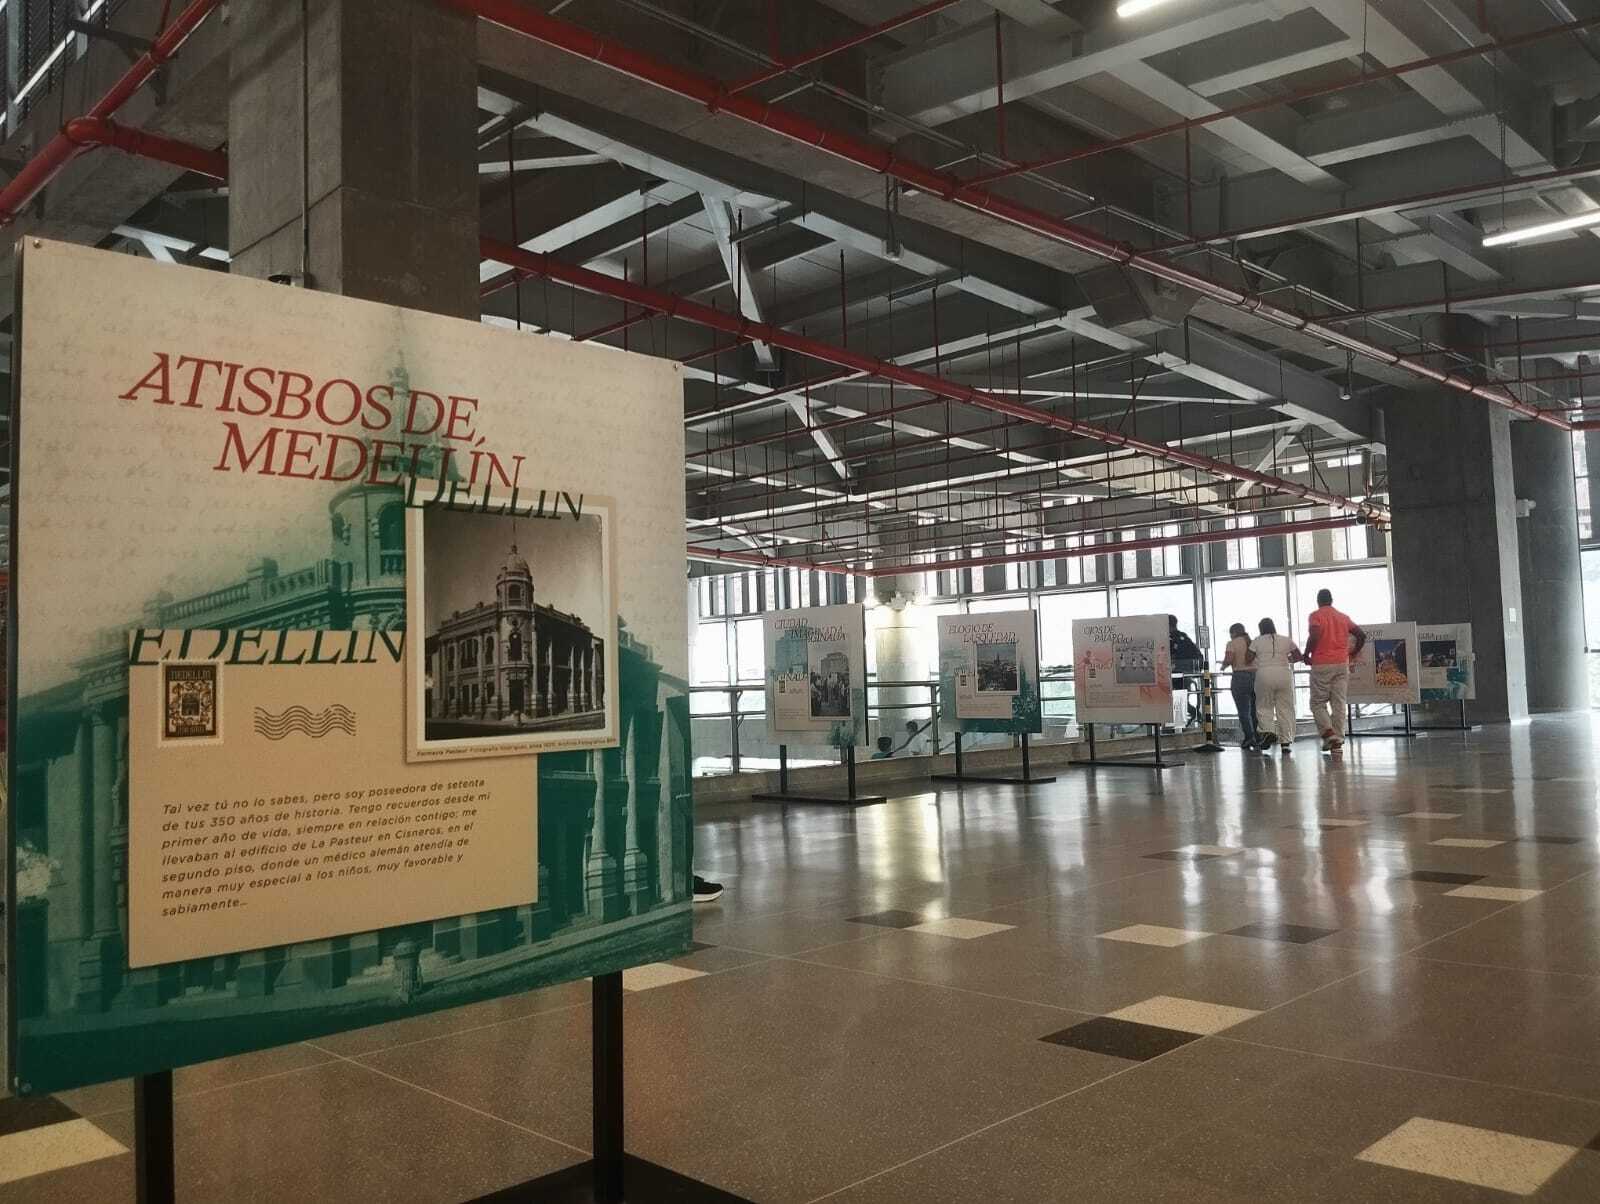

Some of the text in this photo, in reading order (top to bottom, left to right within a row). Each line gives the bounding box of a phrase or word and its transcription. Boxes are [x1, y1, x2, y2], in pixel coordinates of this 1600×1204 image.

[118, 351, 479, 441] ATISBOS DE
[213, 421, 526, 490] MEDELLÍN
[162, 792, 490, 832] de tus 350 años de historia. Tengo recuerdos desde mi
[163, 778, 485, 815] Tal vez tú no lo sabes, pero soy poseedora de setenta
[162, 837, 208, 850] primer
[212, 834, 236, 844] año
[241, 831, 257, 841] de
[262, 826, 291, 838] vida,
[296, 821, 344, 836] siempre
[348, 820, 362, 829] en
[366, 814, 411, 828] relación
[462, 808, 478, 816] me
[162, 822, 474, 866] llevaban al edificio de La Pasteur en Cisneros, en el
[162, 837, 470, 883] segundo piso, donde un médico alemán atendía de
[162, 853, 464, 900] manera muy especial a los niños, muy favorable y
